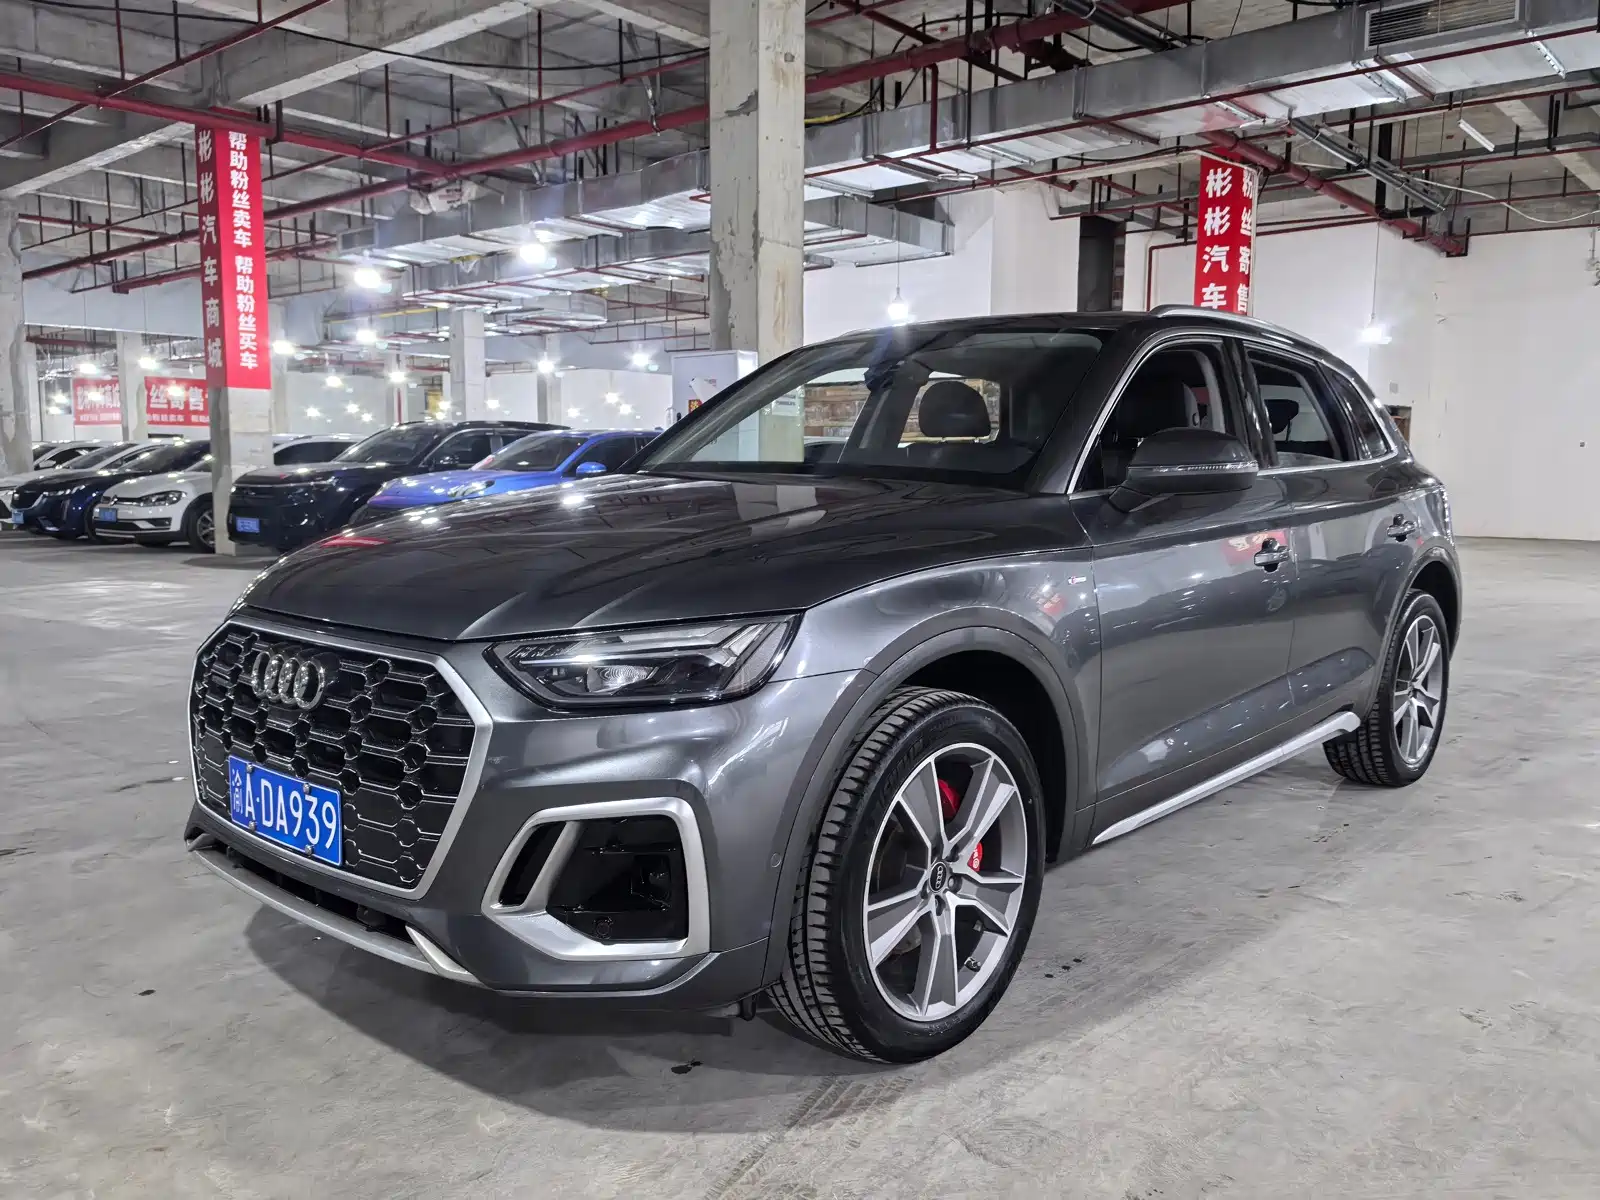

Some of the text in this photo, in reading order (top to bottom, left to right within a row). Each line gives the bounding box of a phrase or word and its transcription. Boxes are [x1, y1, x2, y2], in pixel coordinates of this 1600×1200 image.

[198, 130, 223, 368] 彬彬汽车商城
[229, 131, 258, 369] 帮助粉丝卖车 帮助粉丝买车
[1200, 167, 1232, 309] 彬彬汽车
